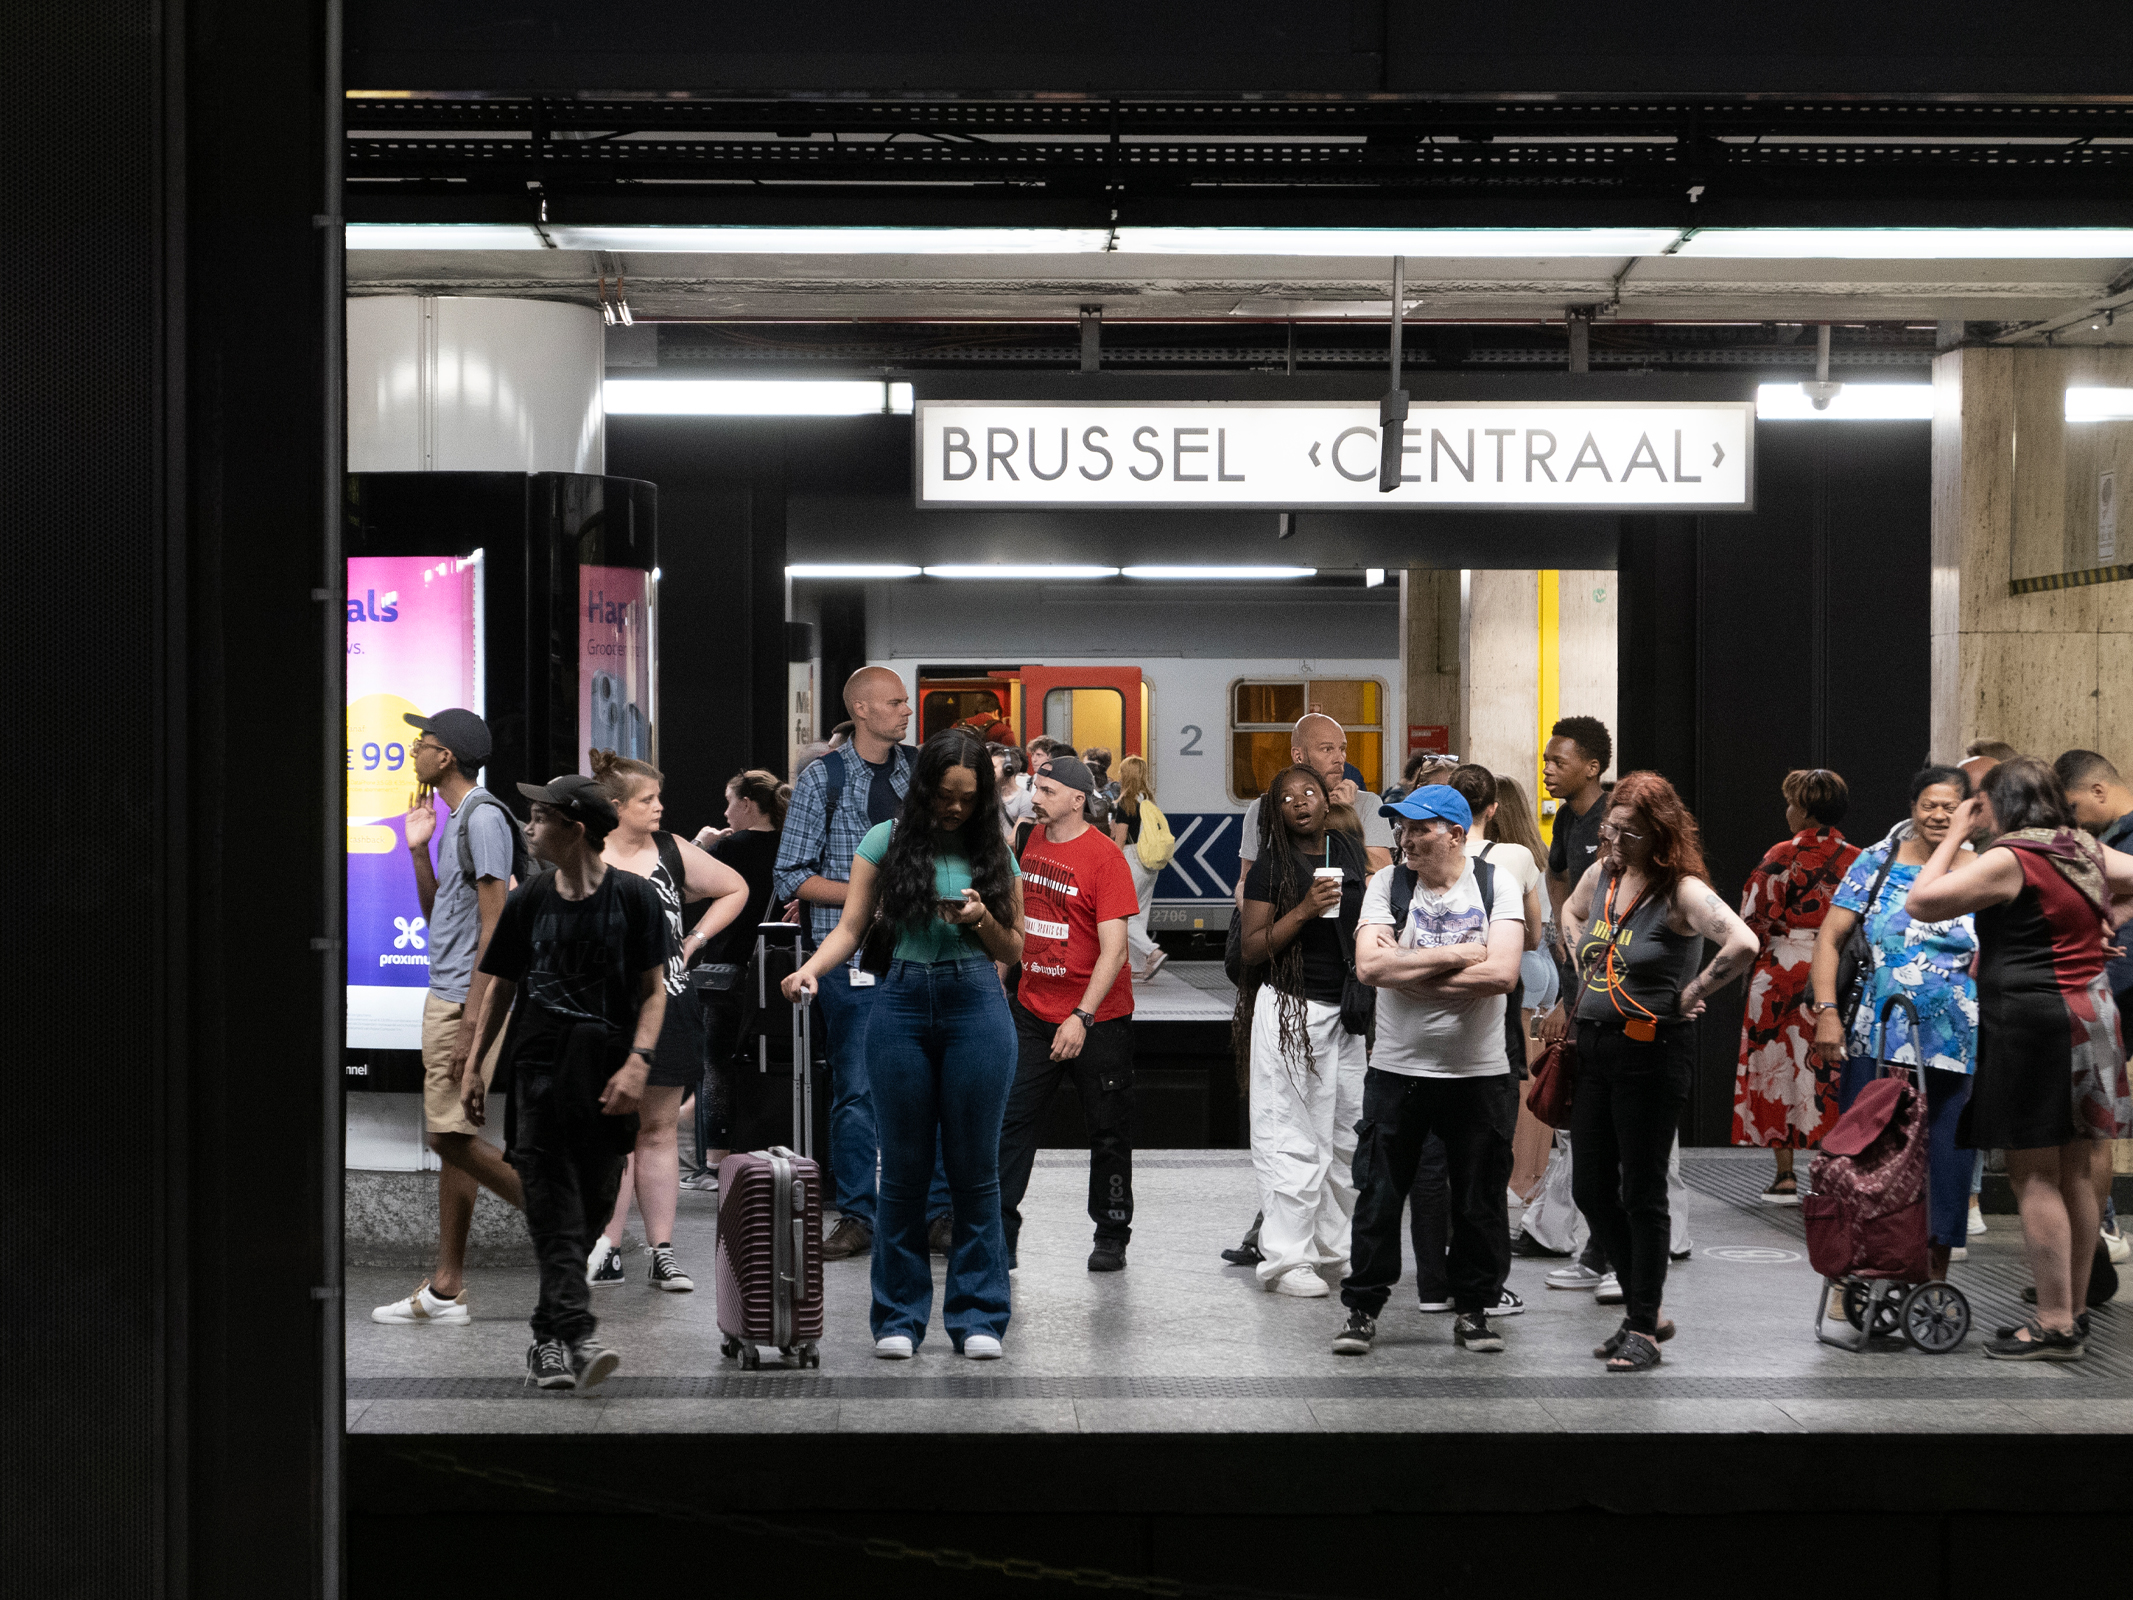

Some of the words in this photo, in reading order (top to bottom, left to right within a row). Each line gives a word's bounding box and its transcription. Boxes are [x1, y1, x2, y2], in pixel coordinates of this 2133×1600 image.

[943, 426, 1246, 483] BRUSSEL
[1180, 724, 1203, 756] 2
[1030, 961, 1067, 977] Supply
